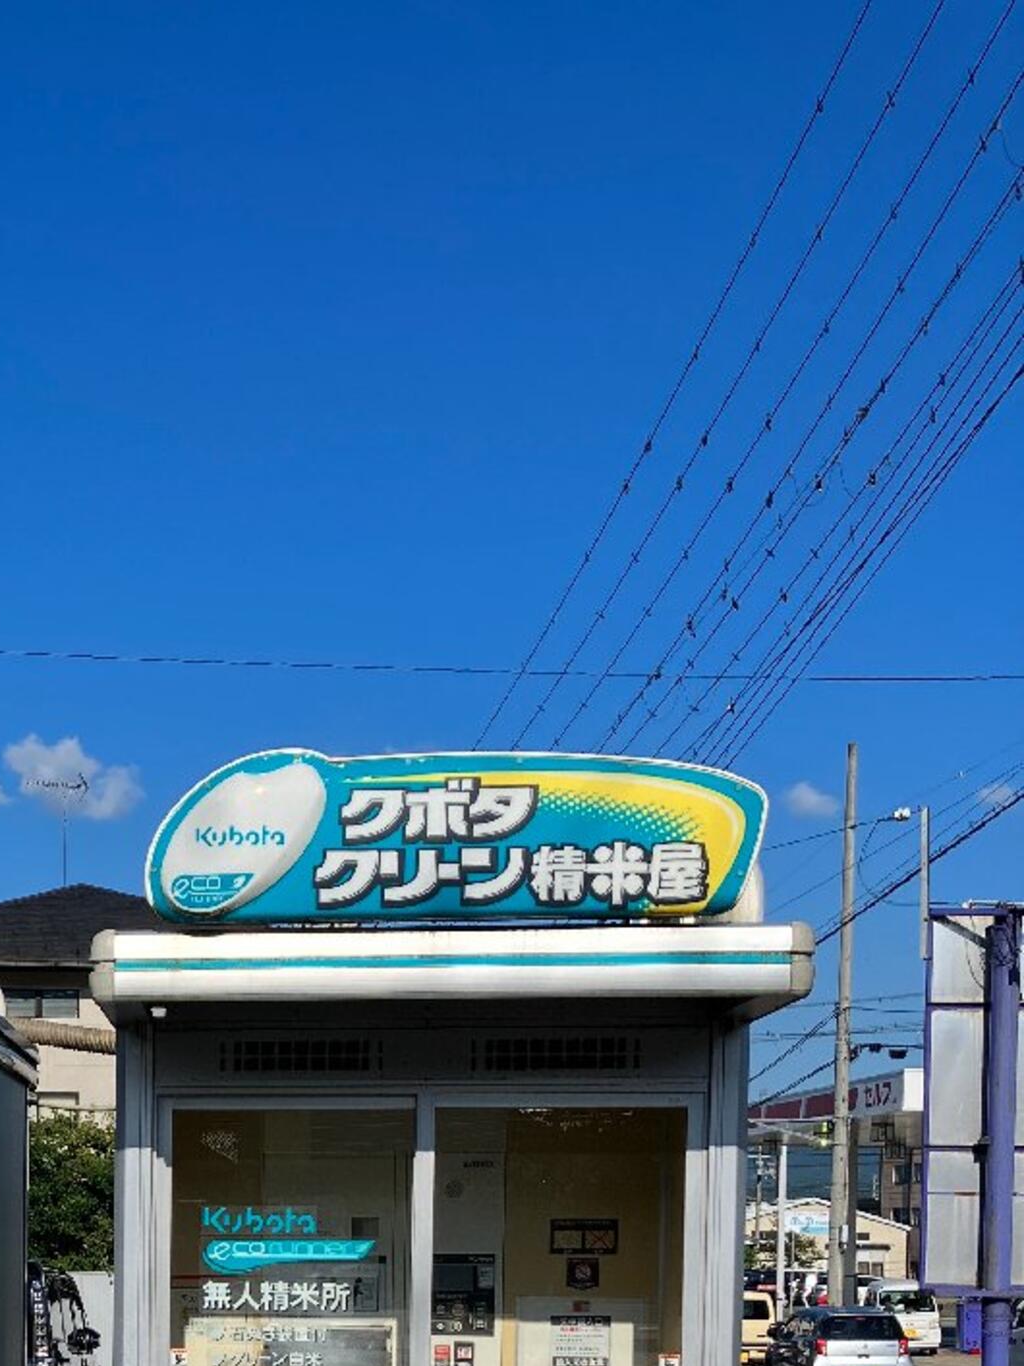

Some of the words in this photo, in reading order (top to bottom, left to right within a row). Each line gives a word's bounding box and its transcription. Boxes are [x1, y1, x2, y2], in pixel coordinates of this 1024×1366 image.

[344, 779, 538, 844] クボタ
[196, 825, 285, 847] Kubota
[314, 839, 708, 909] クリーン精米屋
[202, 1206, 318, 1234] Kubota
[203, 1280, 351, 1311] 無人精米所
